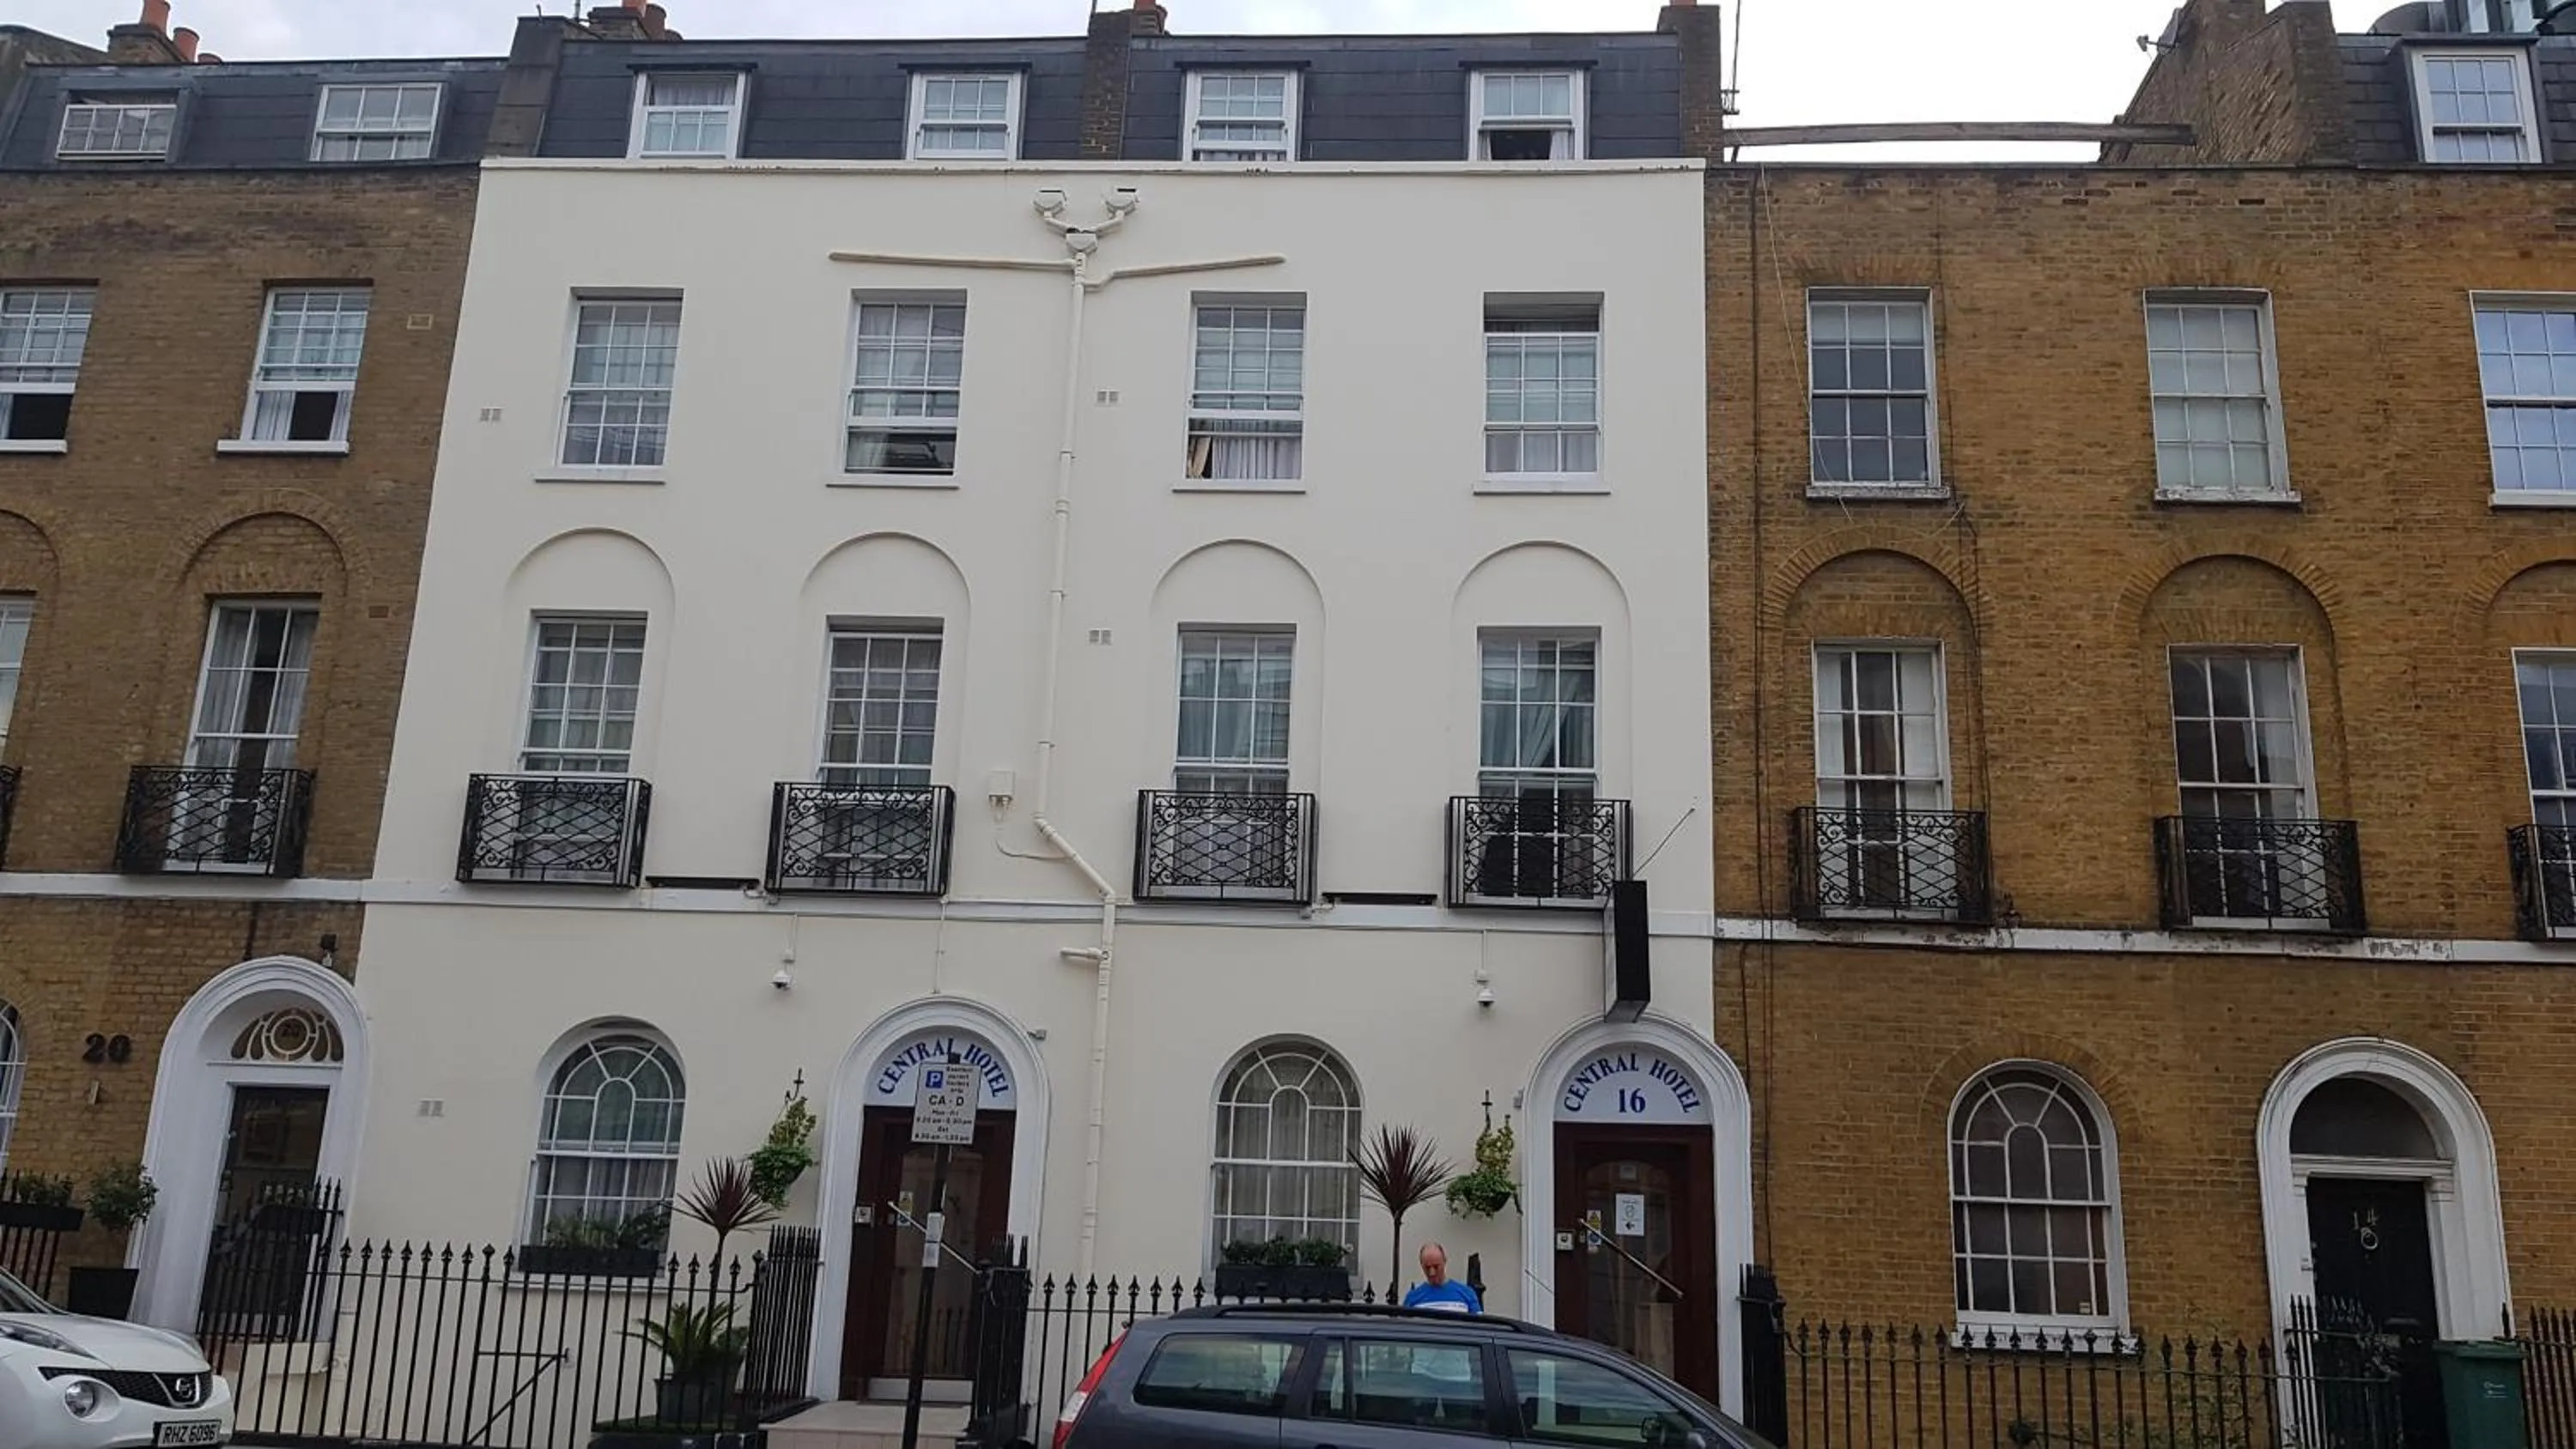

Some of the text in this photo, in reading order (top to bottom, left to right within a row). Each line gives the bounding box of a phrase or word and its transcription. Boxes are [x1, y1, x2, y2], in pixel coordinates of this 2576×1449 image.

[82, 1033, 132, 1063] 20
[878, 1038, 1009, 1098] CENTRAL HOTEL
[1563, 1053, 1701, 1113] CENTRAL HOTEL
[1619, 1088, 1647, 1113] 16
[162, 1425, 188, 1443] RHZ
